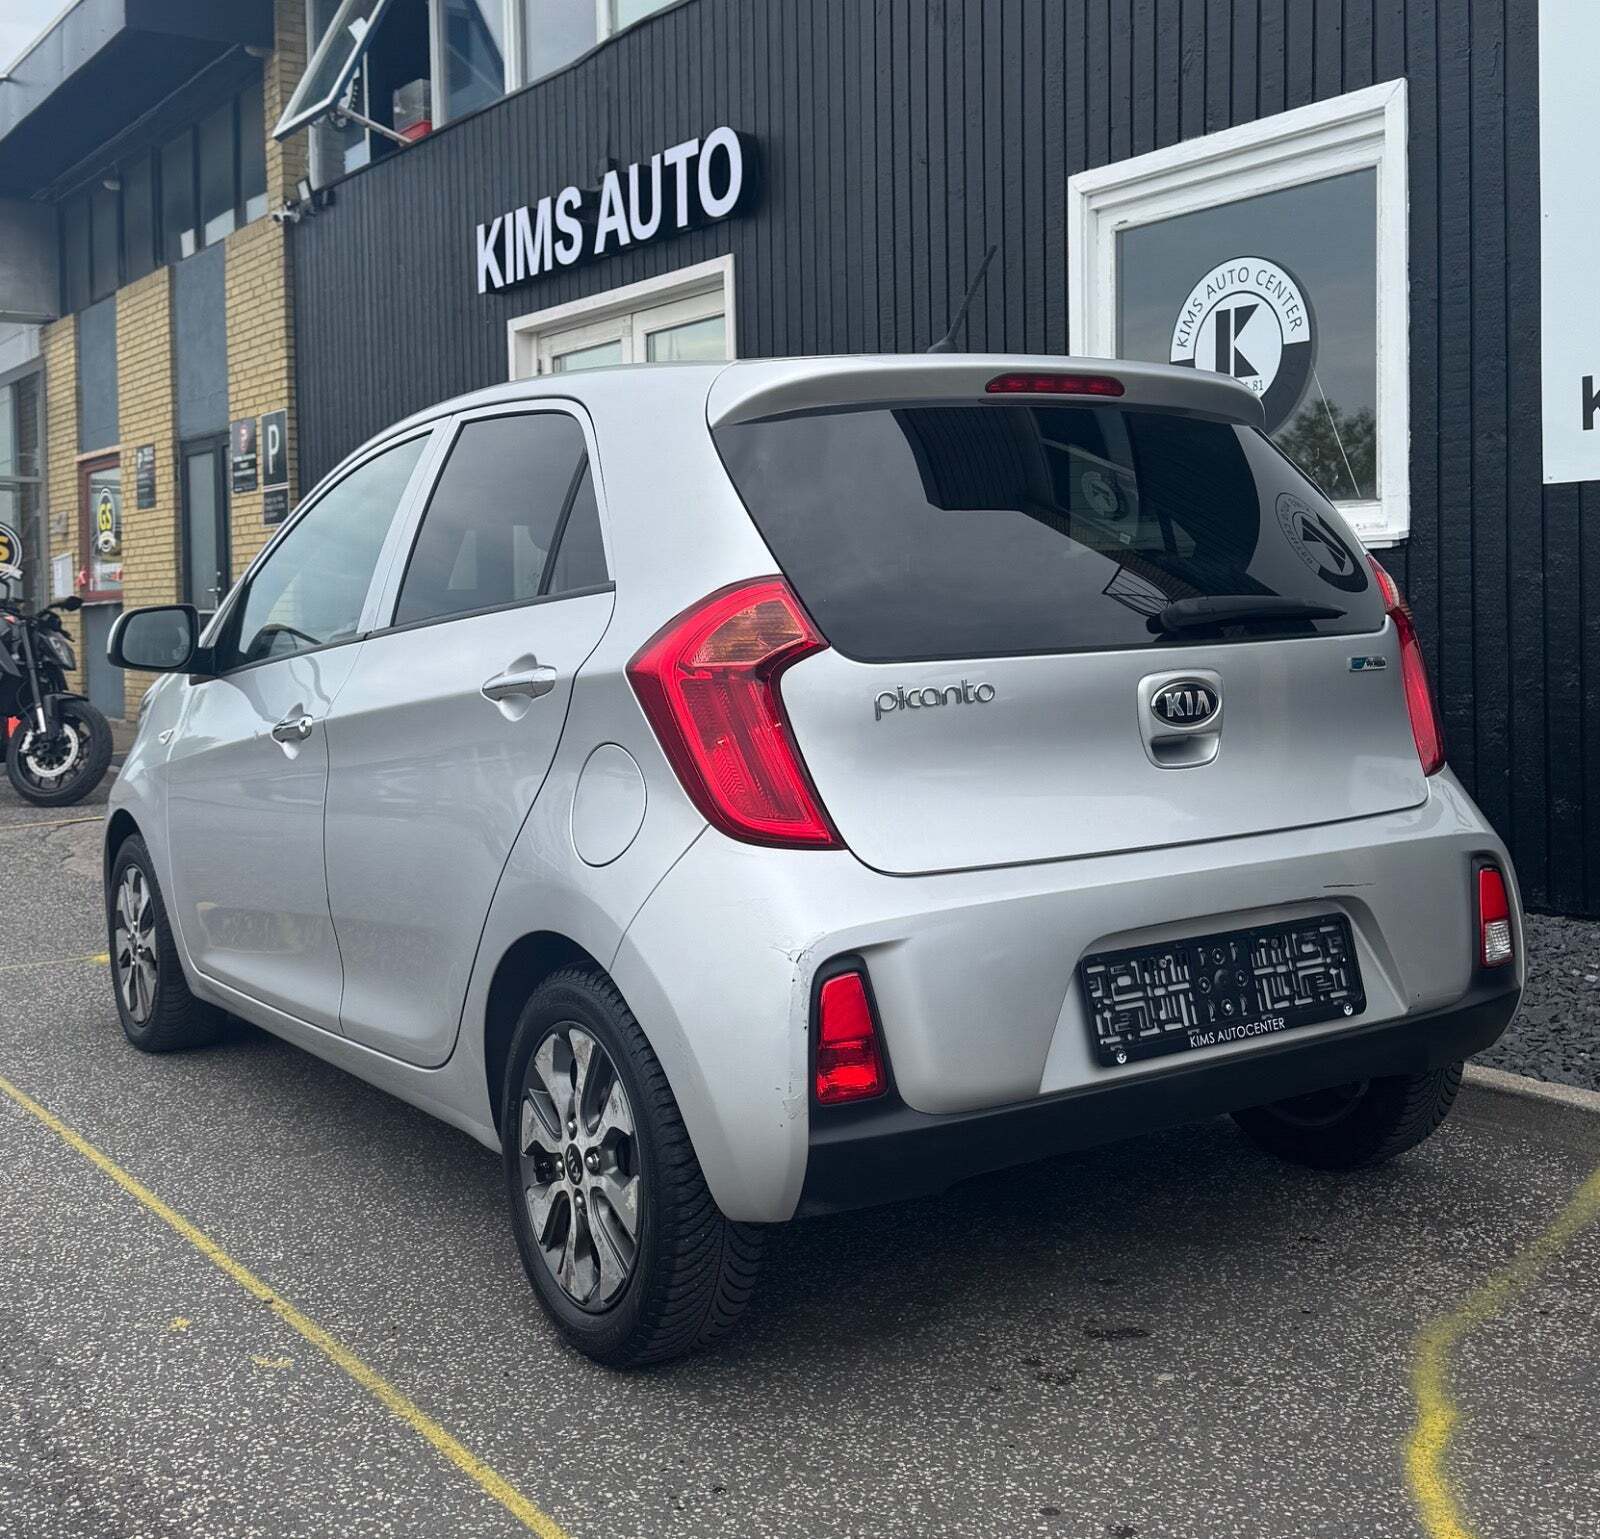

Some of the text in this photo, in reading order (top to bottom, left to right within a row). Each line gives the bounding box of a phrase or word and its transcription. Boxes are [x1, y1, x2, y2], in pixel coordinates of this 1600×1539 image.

[476, 126, 743, 294] KIMS AUTO
[1177, 266, 1303, 348] KIMS AUTO CENTER
[268, 424, 280, 475] P
[874, 678, 996, 722] picanto
[1166, 690, 1211, 718] KIA
[1189, 1018, 1286, 1048] KIMS AUTOCENTER
